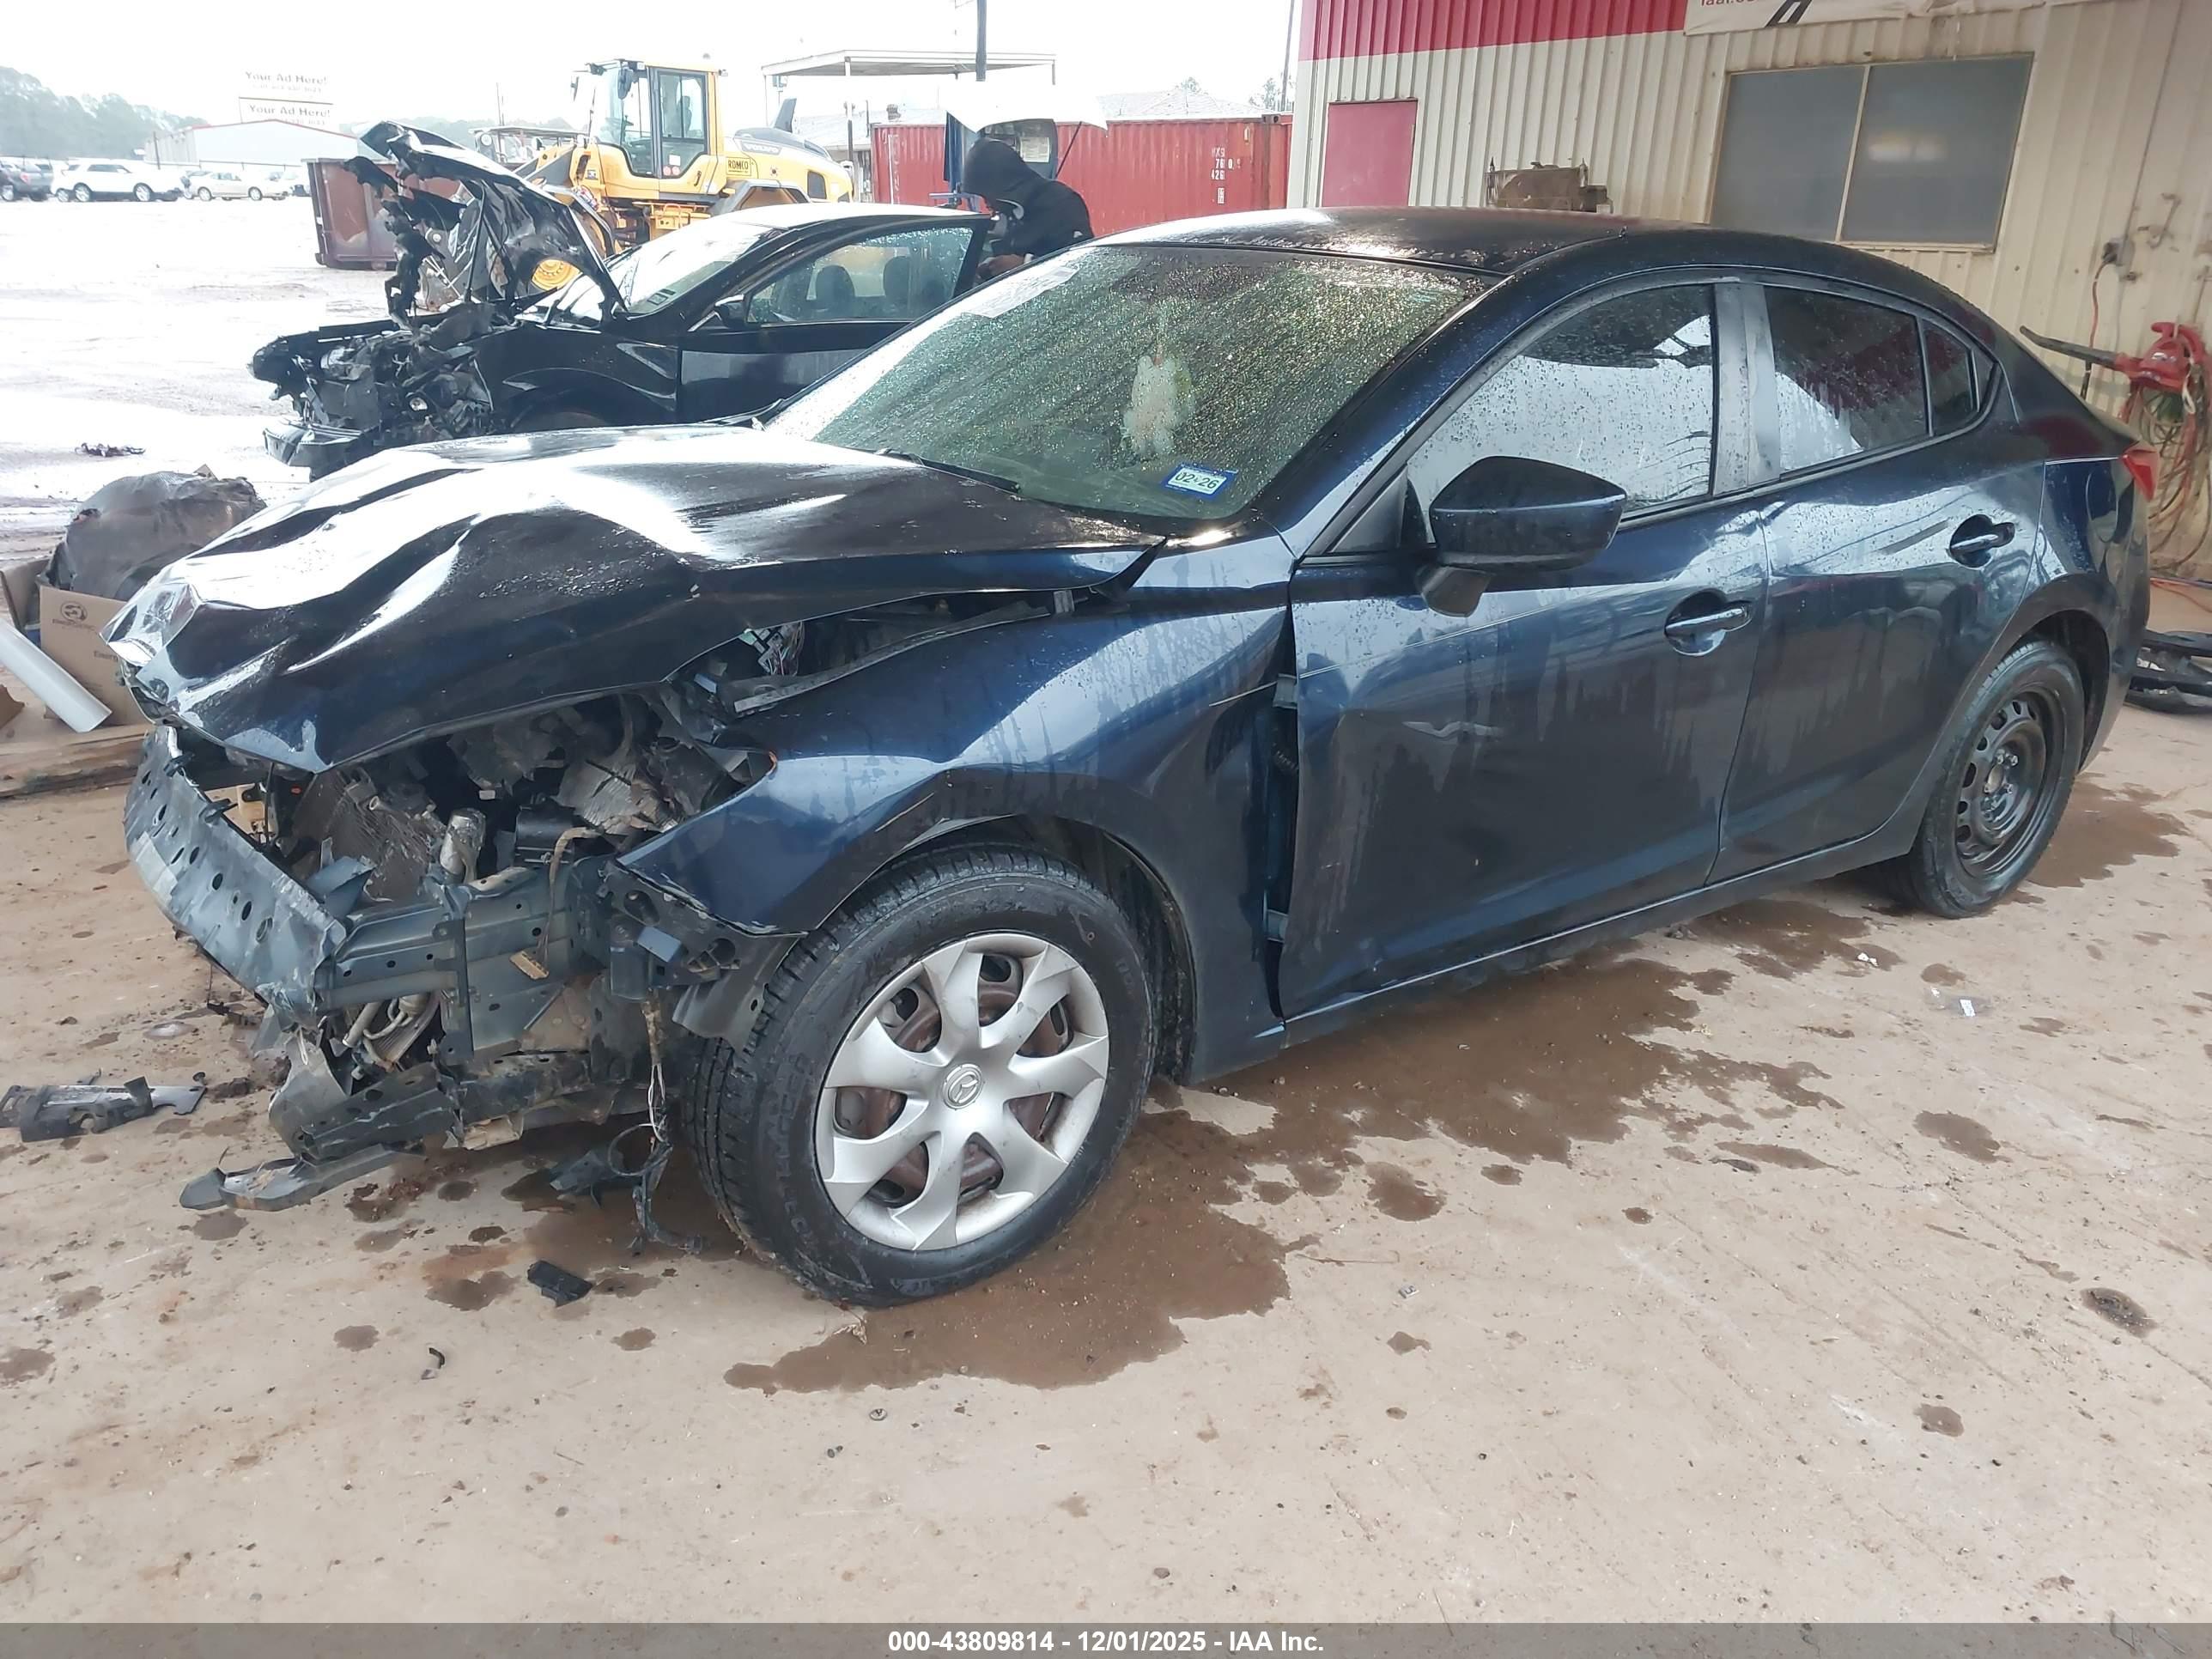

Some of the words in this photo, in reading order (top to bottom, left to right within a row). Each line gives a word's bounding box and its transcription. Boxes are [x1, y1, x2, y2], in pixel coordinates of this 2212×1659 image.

[245, 70, 271, 82] Your
[276, 73, 292, 82] Ad
[295, 75, 327, 85] Here!
[249, 104, 276, 114] Your
[280, 106, 295, 115] Ad
[299, 107, 331, 117] Here!
[728, 160, 749, 171] ROMCO
